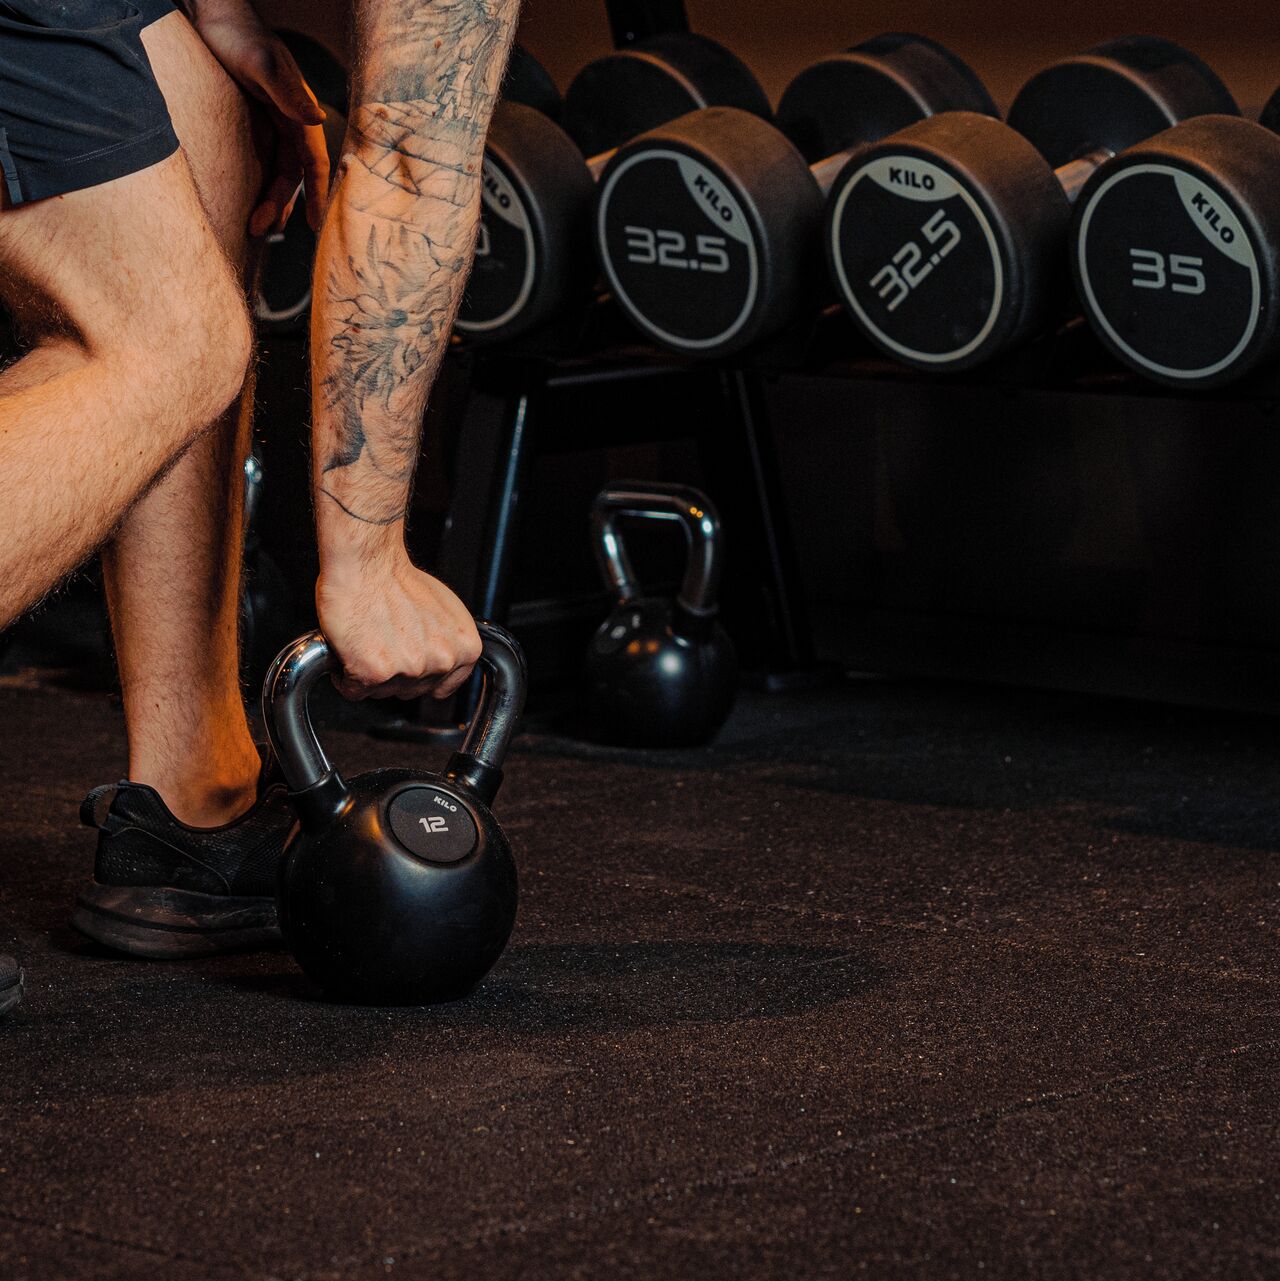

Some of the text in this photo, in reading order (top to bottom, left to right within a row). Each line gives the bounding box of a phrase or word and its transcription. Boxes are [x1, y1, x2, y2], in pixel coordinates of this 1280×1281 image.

[693, 175, 733, 222] KILO
[889, 167, 936, 191] KILO
[1191, 191, 1235, 244] KILO
[625, 225, 730, 273] 32.5
[869, 208, 961, 311] 32.5
[1129, 248, 1206, 295] 35
[418, 816, 449, 833] 12
[433, 795, 458, 813] KILO
